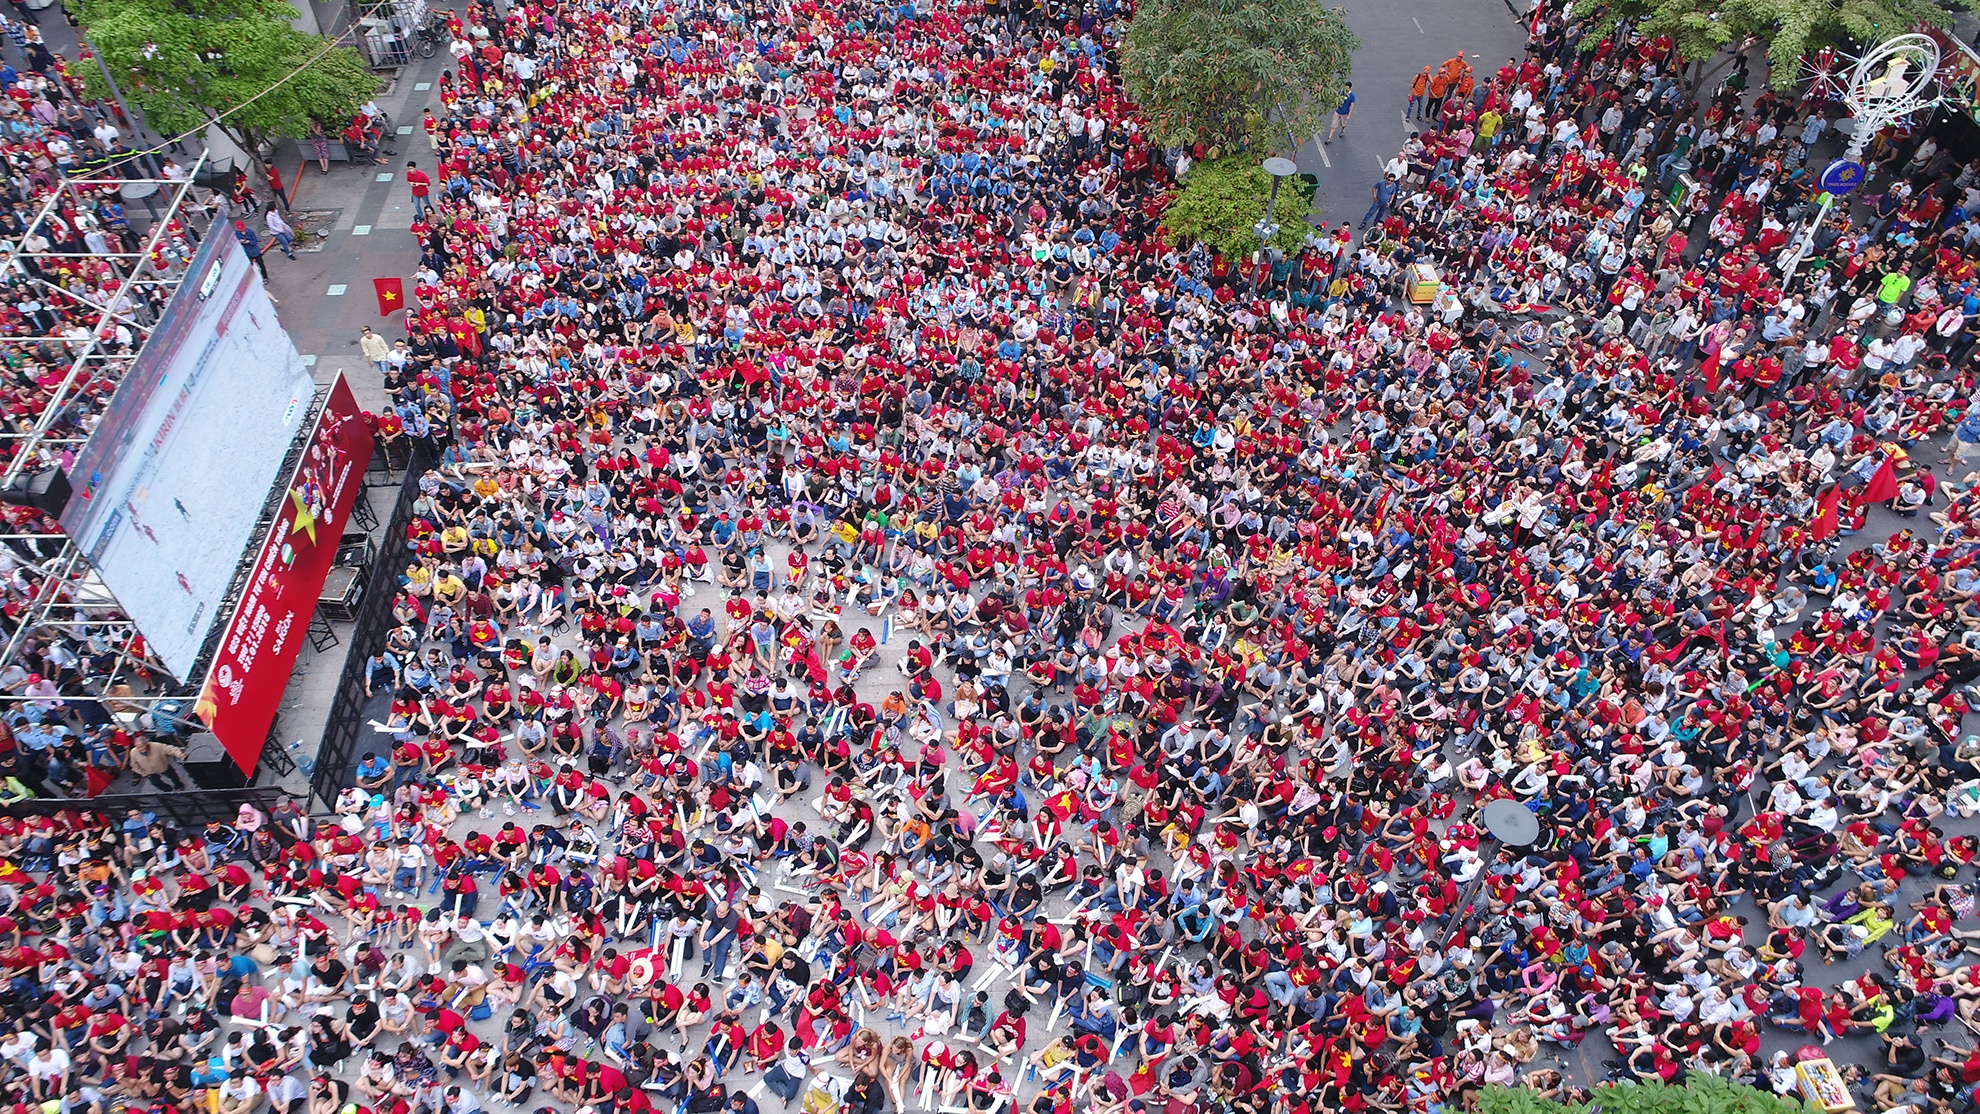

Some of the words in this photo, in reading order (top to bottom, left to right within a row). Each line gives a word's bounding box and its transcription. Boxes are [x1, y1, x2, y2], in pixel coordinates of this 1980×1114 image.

[154, 411, 176, 448] KIRIN
[257, 567, 269, 585] TIN
[252, 580, 263, 596] TỰ
[243, 593, 258, 618] NAM
[235, 614, 249, 636] VIỆT
[251, 604, 266, 632] 15H00
[228, 634, 240, 654] U23
[242, 612, 270, 673] 27.01.2018
